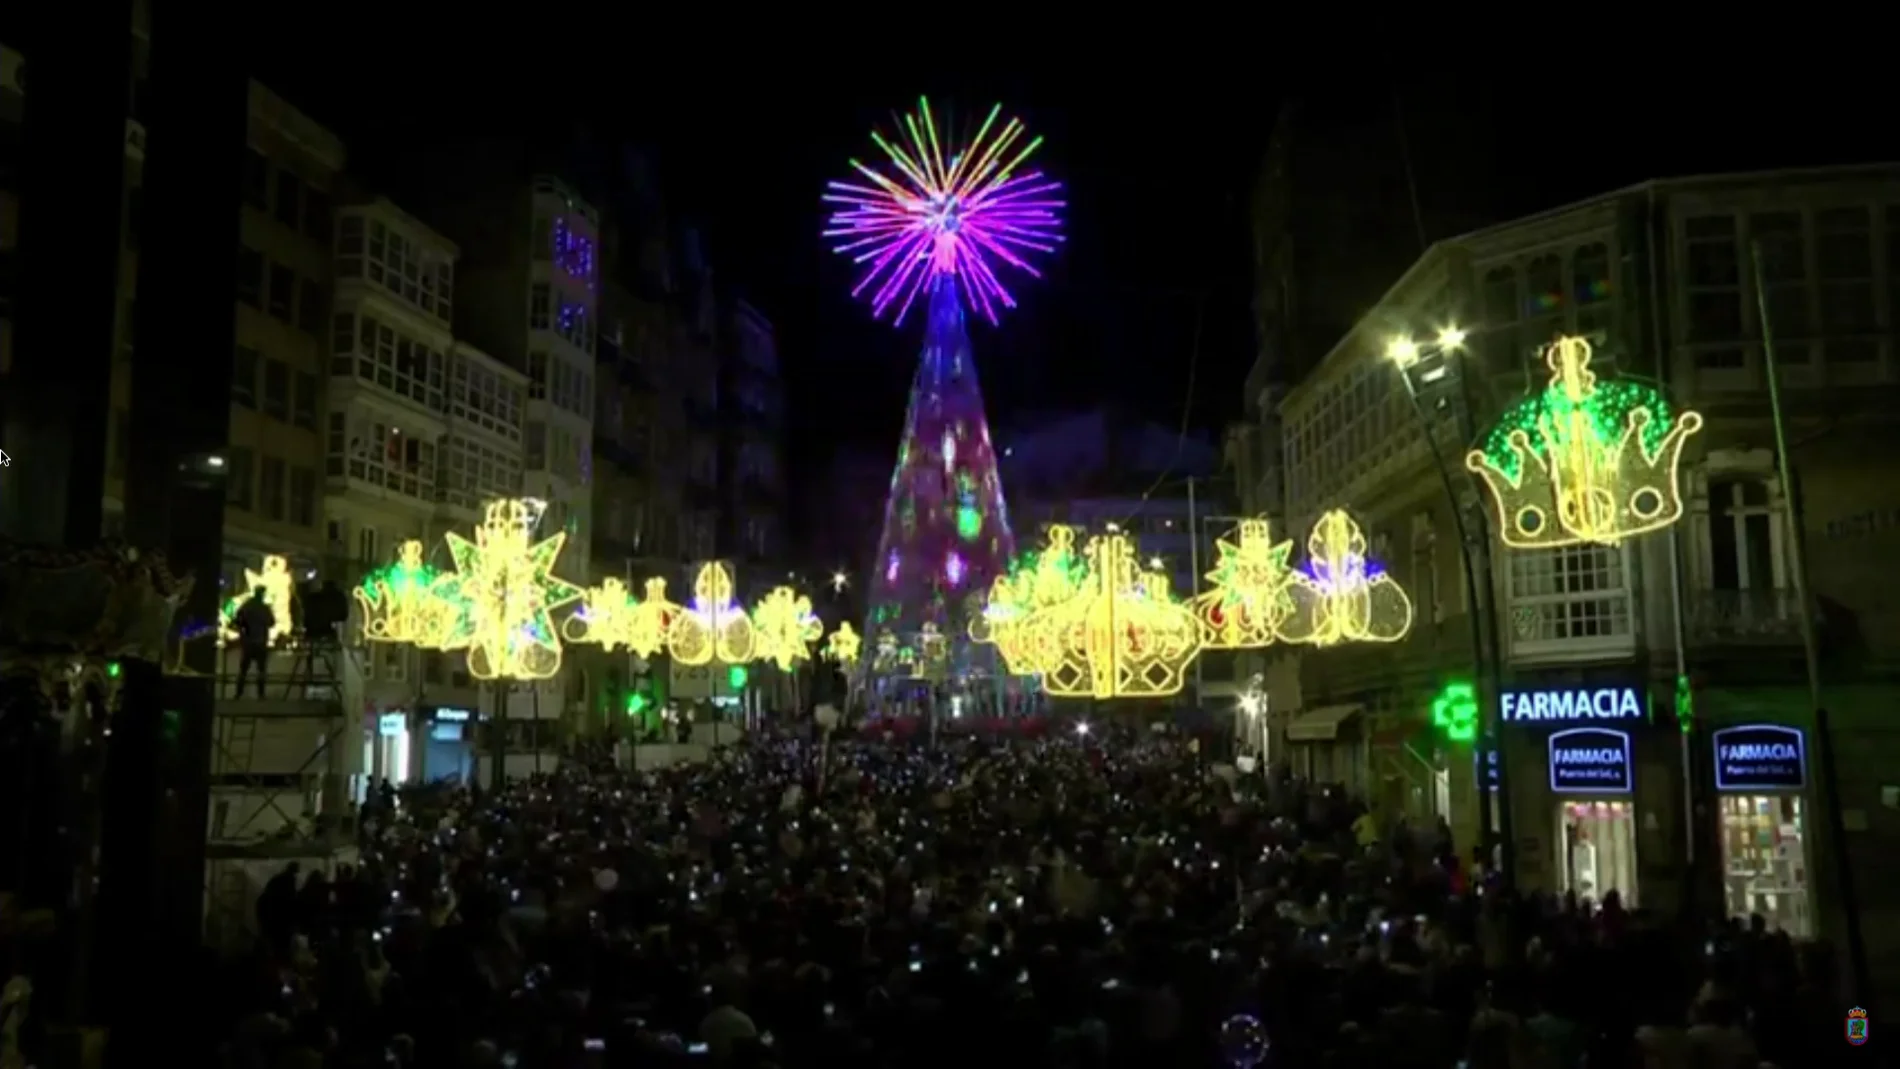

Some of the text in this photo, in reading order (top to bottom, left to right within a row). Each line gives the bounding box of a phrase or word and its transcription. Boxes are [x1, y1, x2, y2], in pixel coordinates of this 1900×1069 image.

[1501, 688, 1640, 720] FARMACIA
[1555, 748, 1623, 764] FARMACIA
[1720, 743, 1797, 760] FARMACIA
